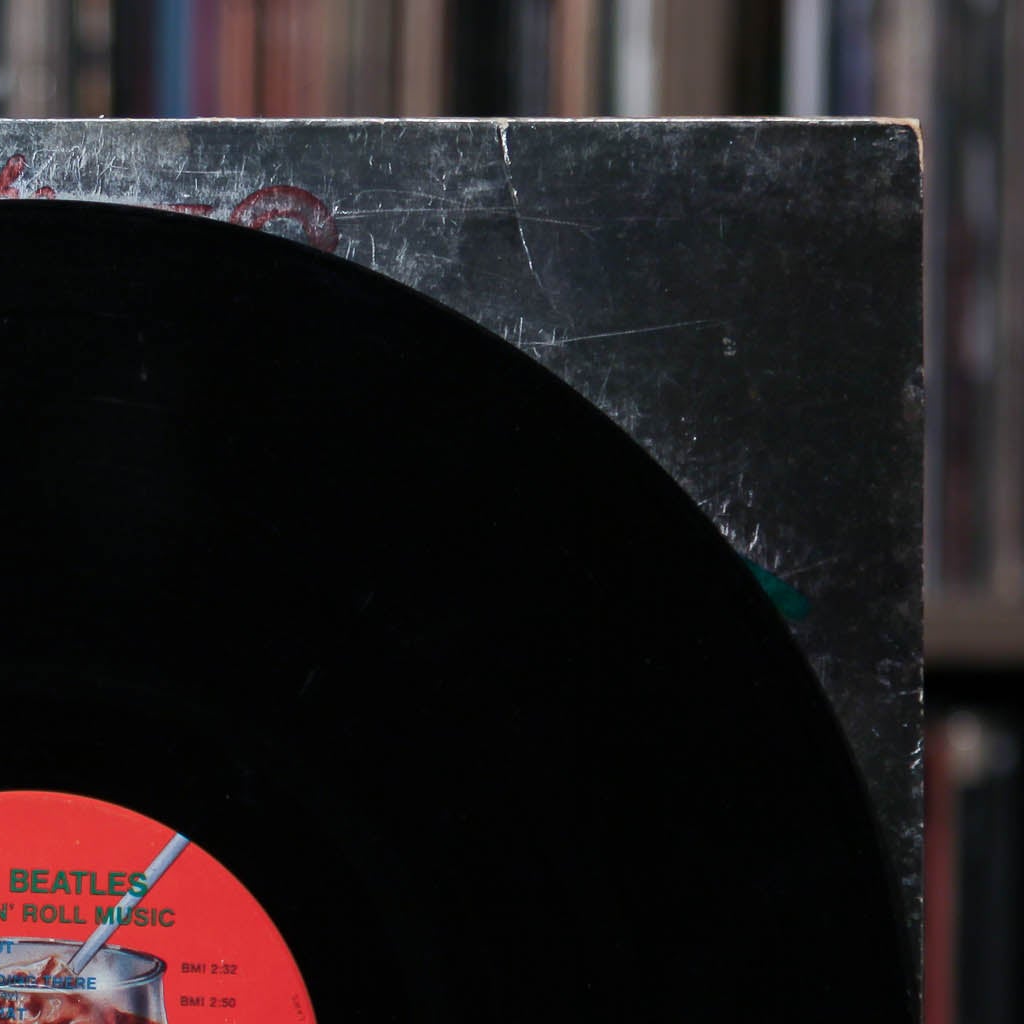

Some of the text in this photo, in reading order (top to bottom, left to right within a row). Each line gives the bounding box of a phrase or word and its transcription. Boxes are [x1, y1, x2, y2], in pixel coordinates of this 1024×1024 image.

[9, 868, 149, 898] BEATLES
[22, 903, 86, 925] ROLL
[95, 905, 176, 927] MUSIC
[181, 962, 206, 974] BMI
[42, 975, 97, 990] THERE
[179, 996, 205, 1008] BMI
